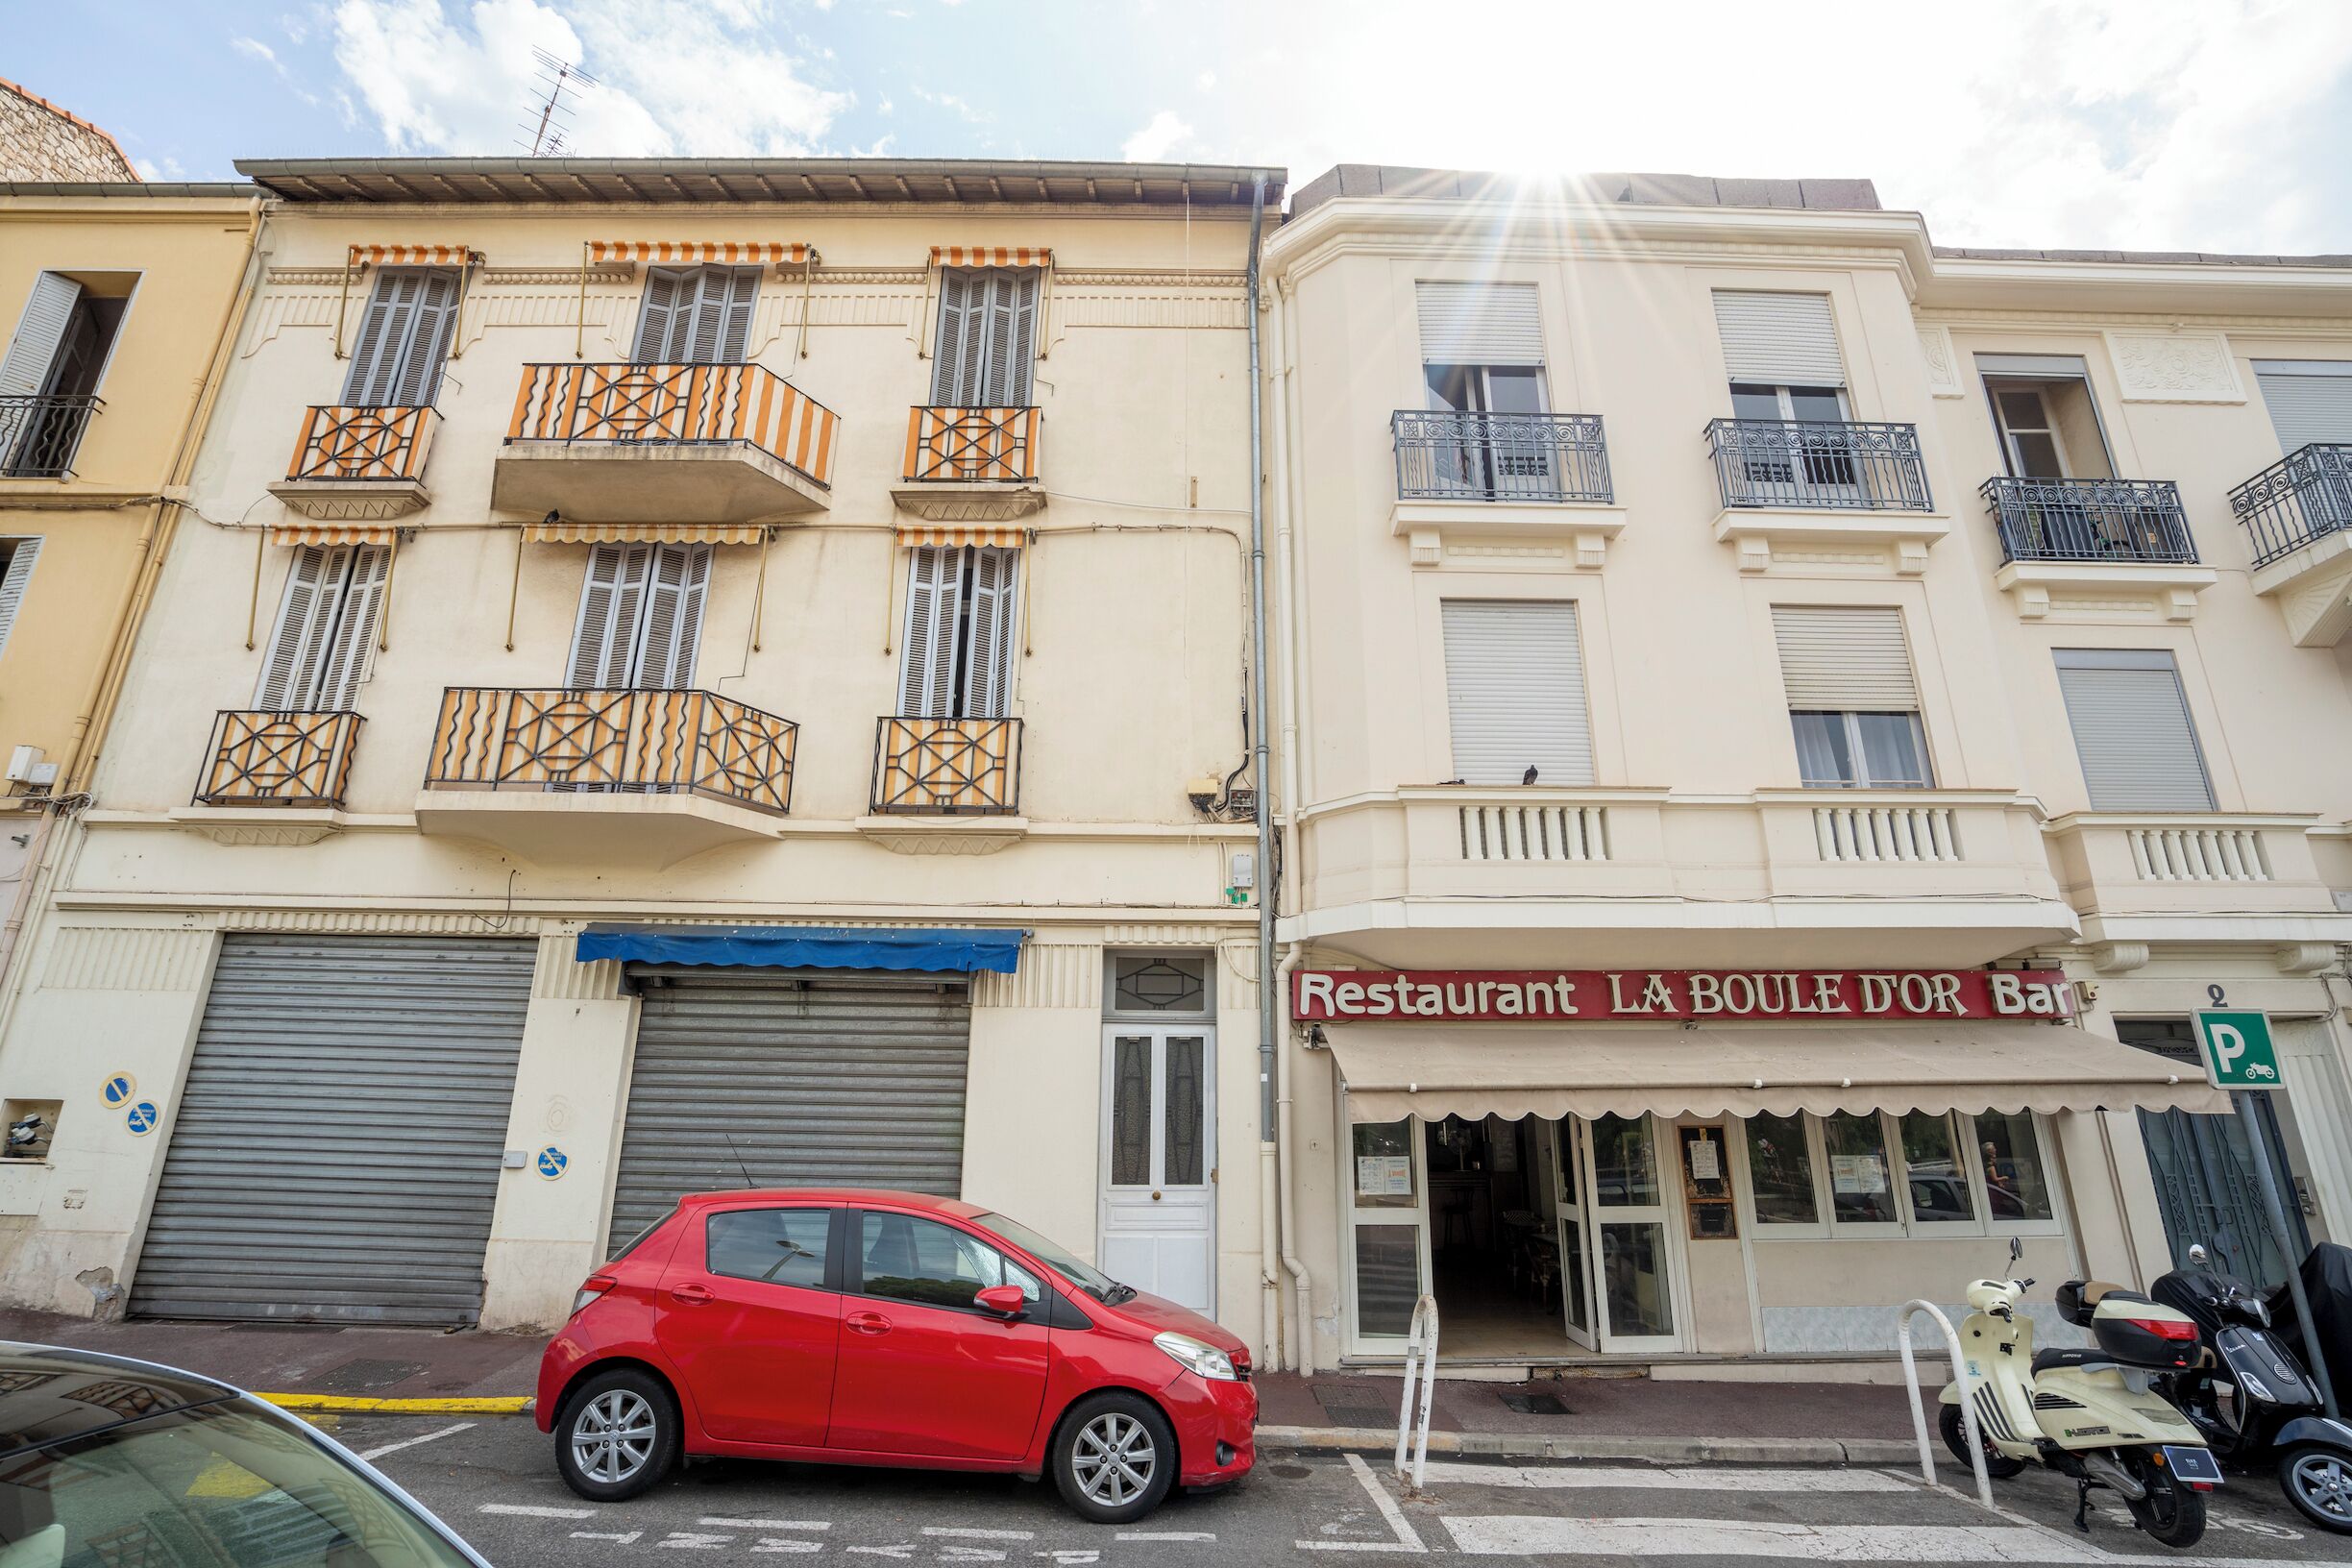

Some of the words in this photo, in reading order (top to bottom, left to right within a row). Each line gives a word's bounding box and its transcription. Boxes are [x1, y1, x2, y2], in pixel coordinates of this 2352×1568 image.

[1300, 973, 1579, 1017] Restaurant
[1607, 974, 1679, 1013] LA
[1689, 974, 1852, 1014] BOULE
[1858, 974, 1969, 1016] D'OR
[1991, 973, 2070, 1015] Bar
[2207, 984, 2228, 1007] 2
[2209, 1023, 2245, 1073] P
